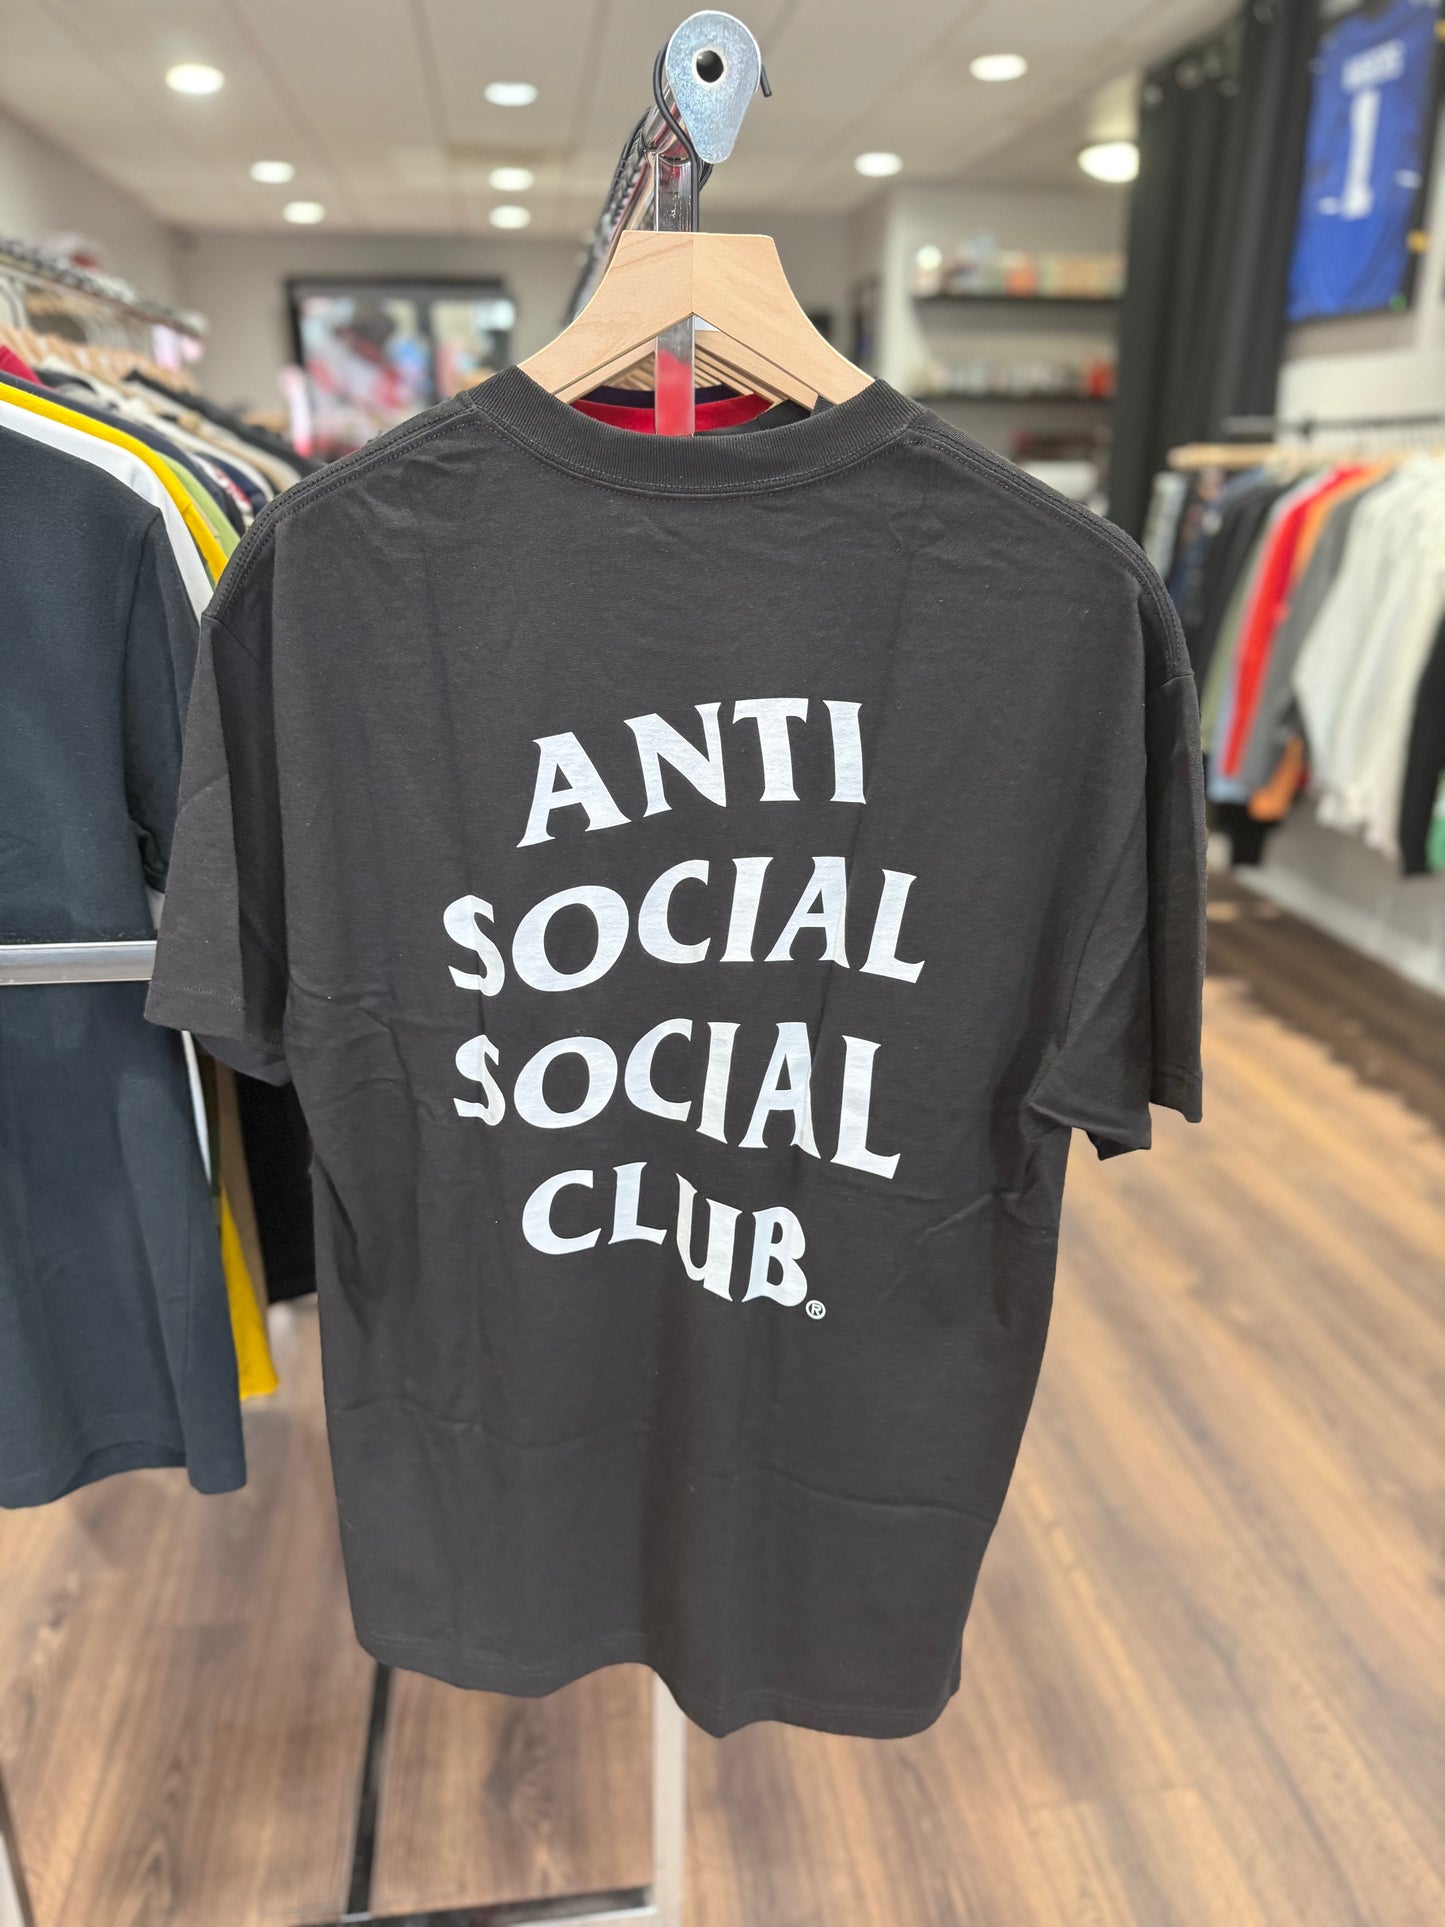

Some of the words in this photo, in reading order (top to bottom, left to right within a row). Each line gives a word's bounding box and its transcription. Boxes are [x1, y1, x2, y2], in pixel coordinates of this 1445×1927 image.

[516, 698, 867, 848] ANTI
[443, 857, 926, 997] SOCIAL
[453, 1018, 901, 1179] SOCIAL
[522, 1162, 808, 1307] CLUB
